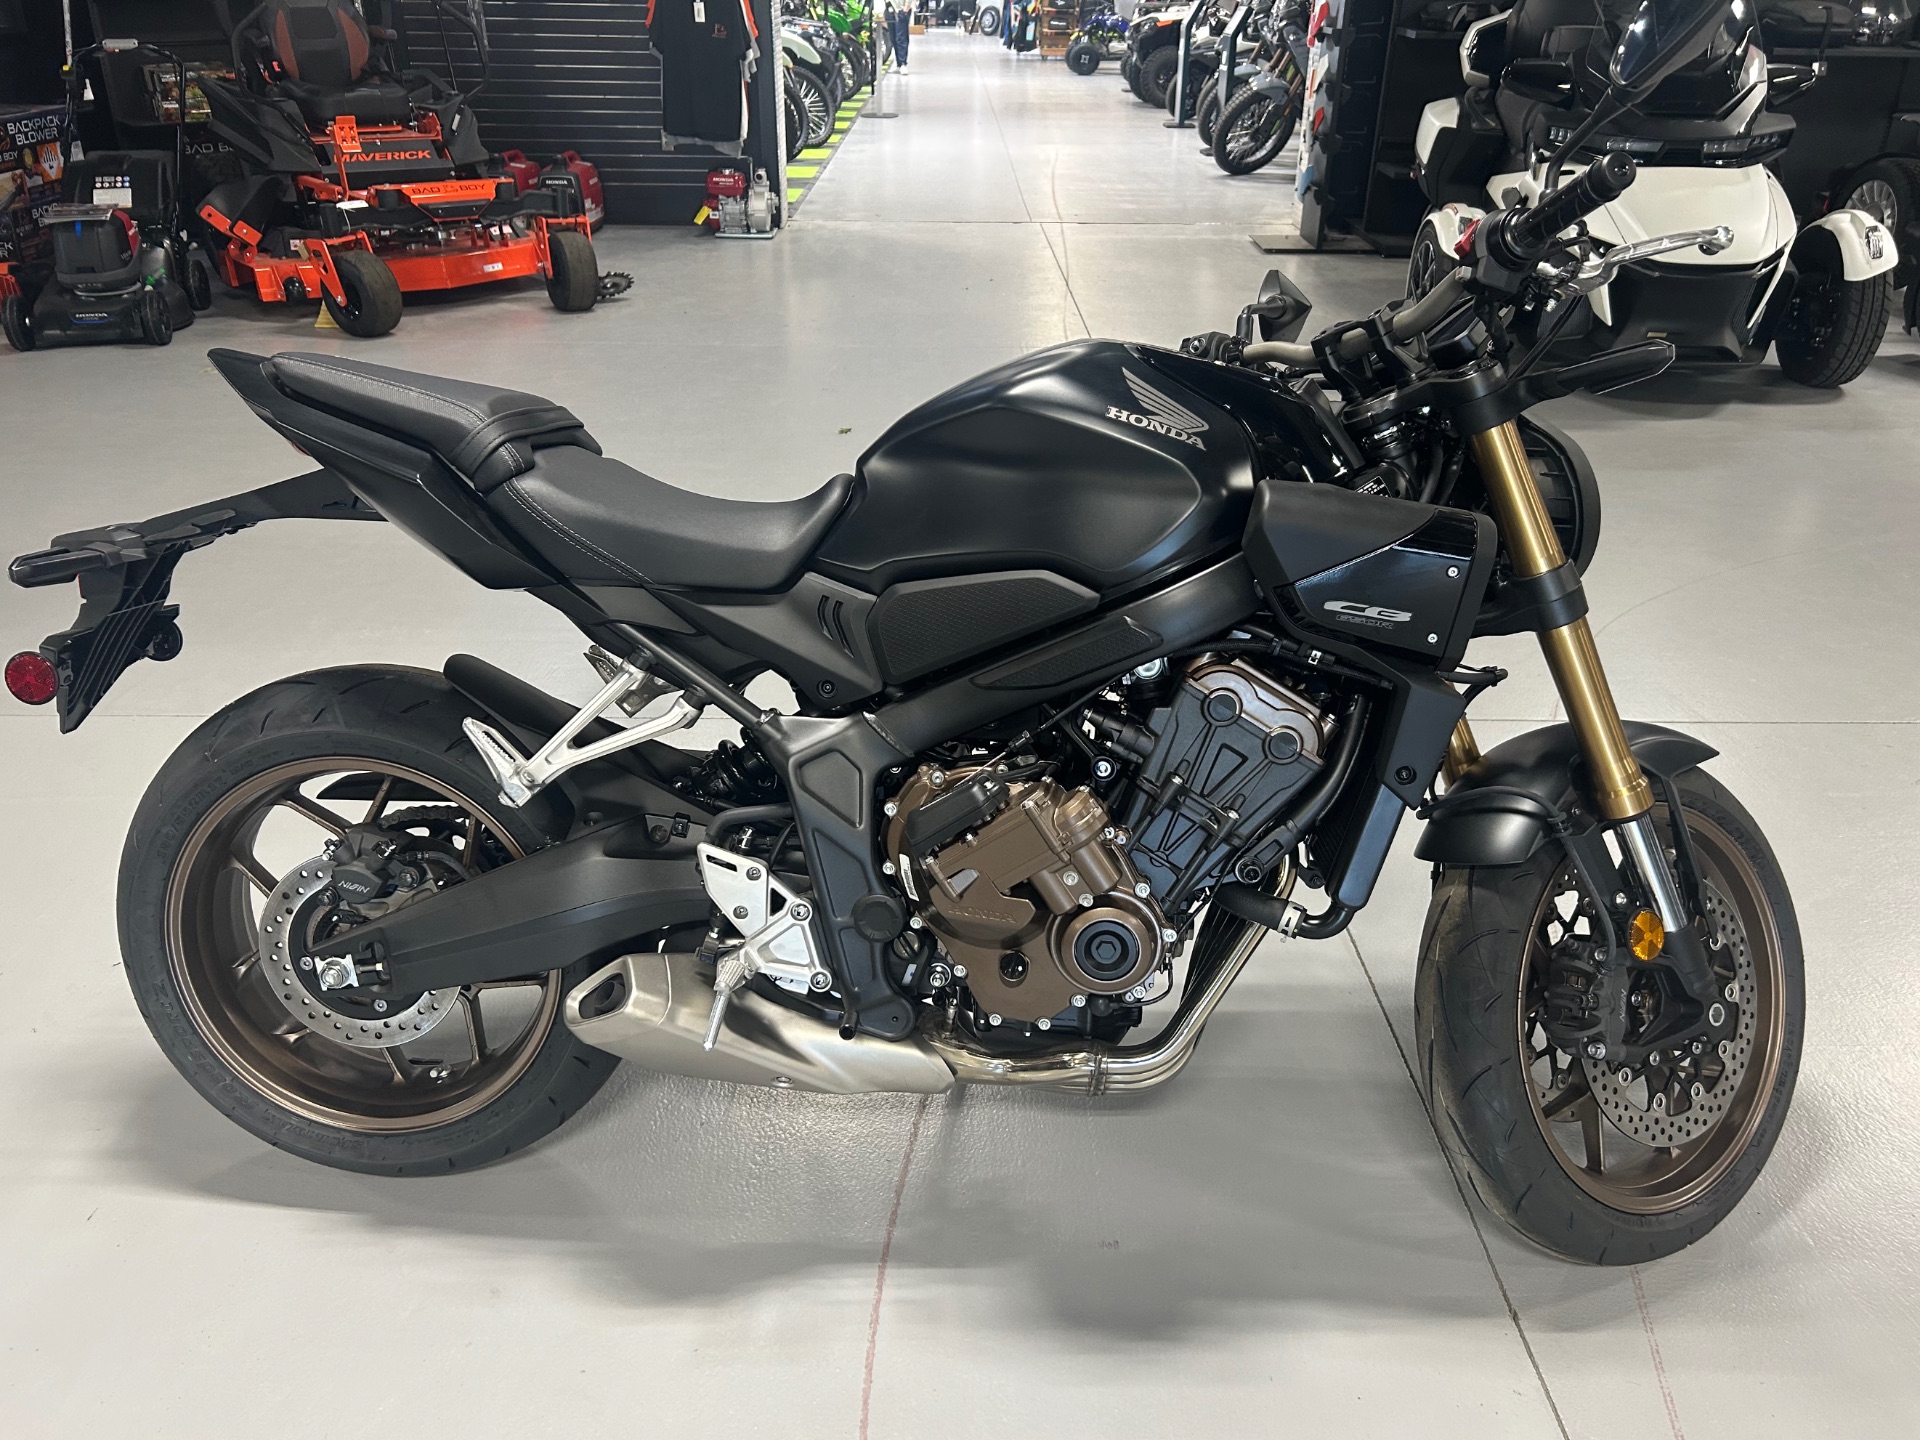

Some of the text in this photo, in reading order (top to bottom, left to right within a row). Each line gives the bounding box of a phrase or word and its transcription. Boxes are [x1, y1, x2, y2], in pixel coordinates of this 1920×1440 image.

[7, 115, 60, 134] BACKPACK
[15, 127, 58, 145] BLOWER
[334, 150, 431, 163] MAVERICK
[412, 183, 486, 195] BAD BOY
[1105, 405, 1207, 451] HONDA
[1323, 600, 1412, 622] CB
[947, 904, 1017, 923] HONDA
